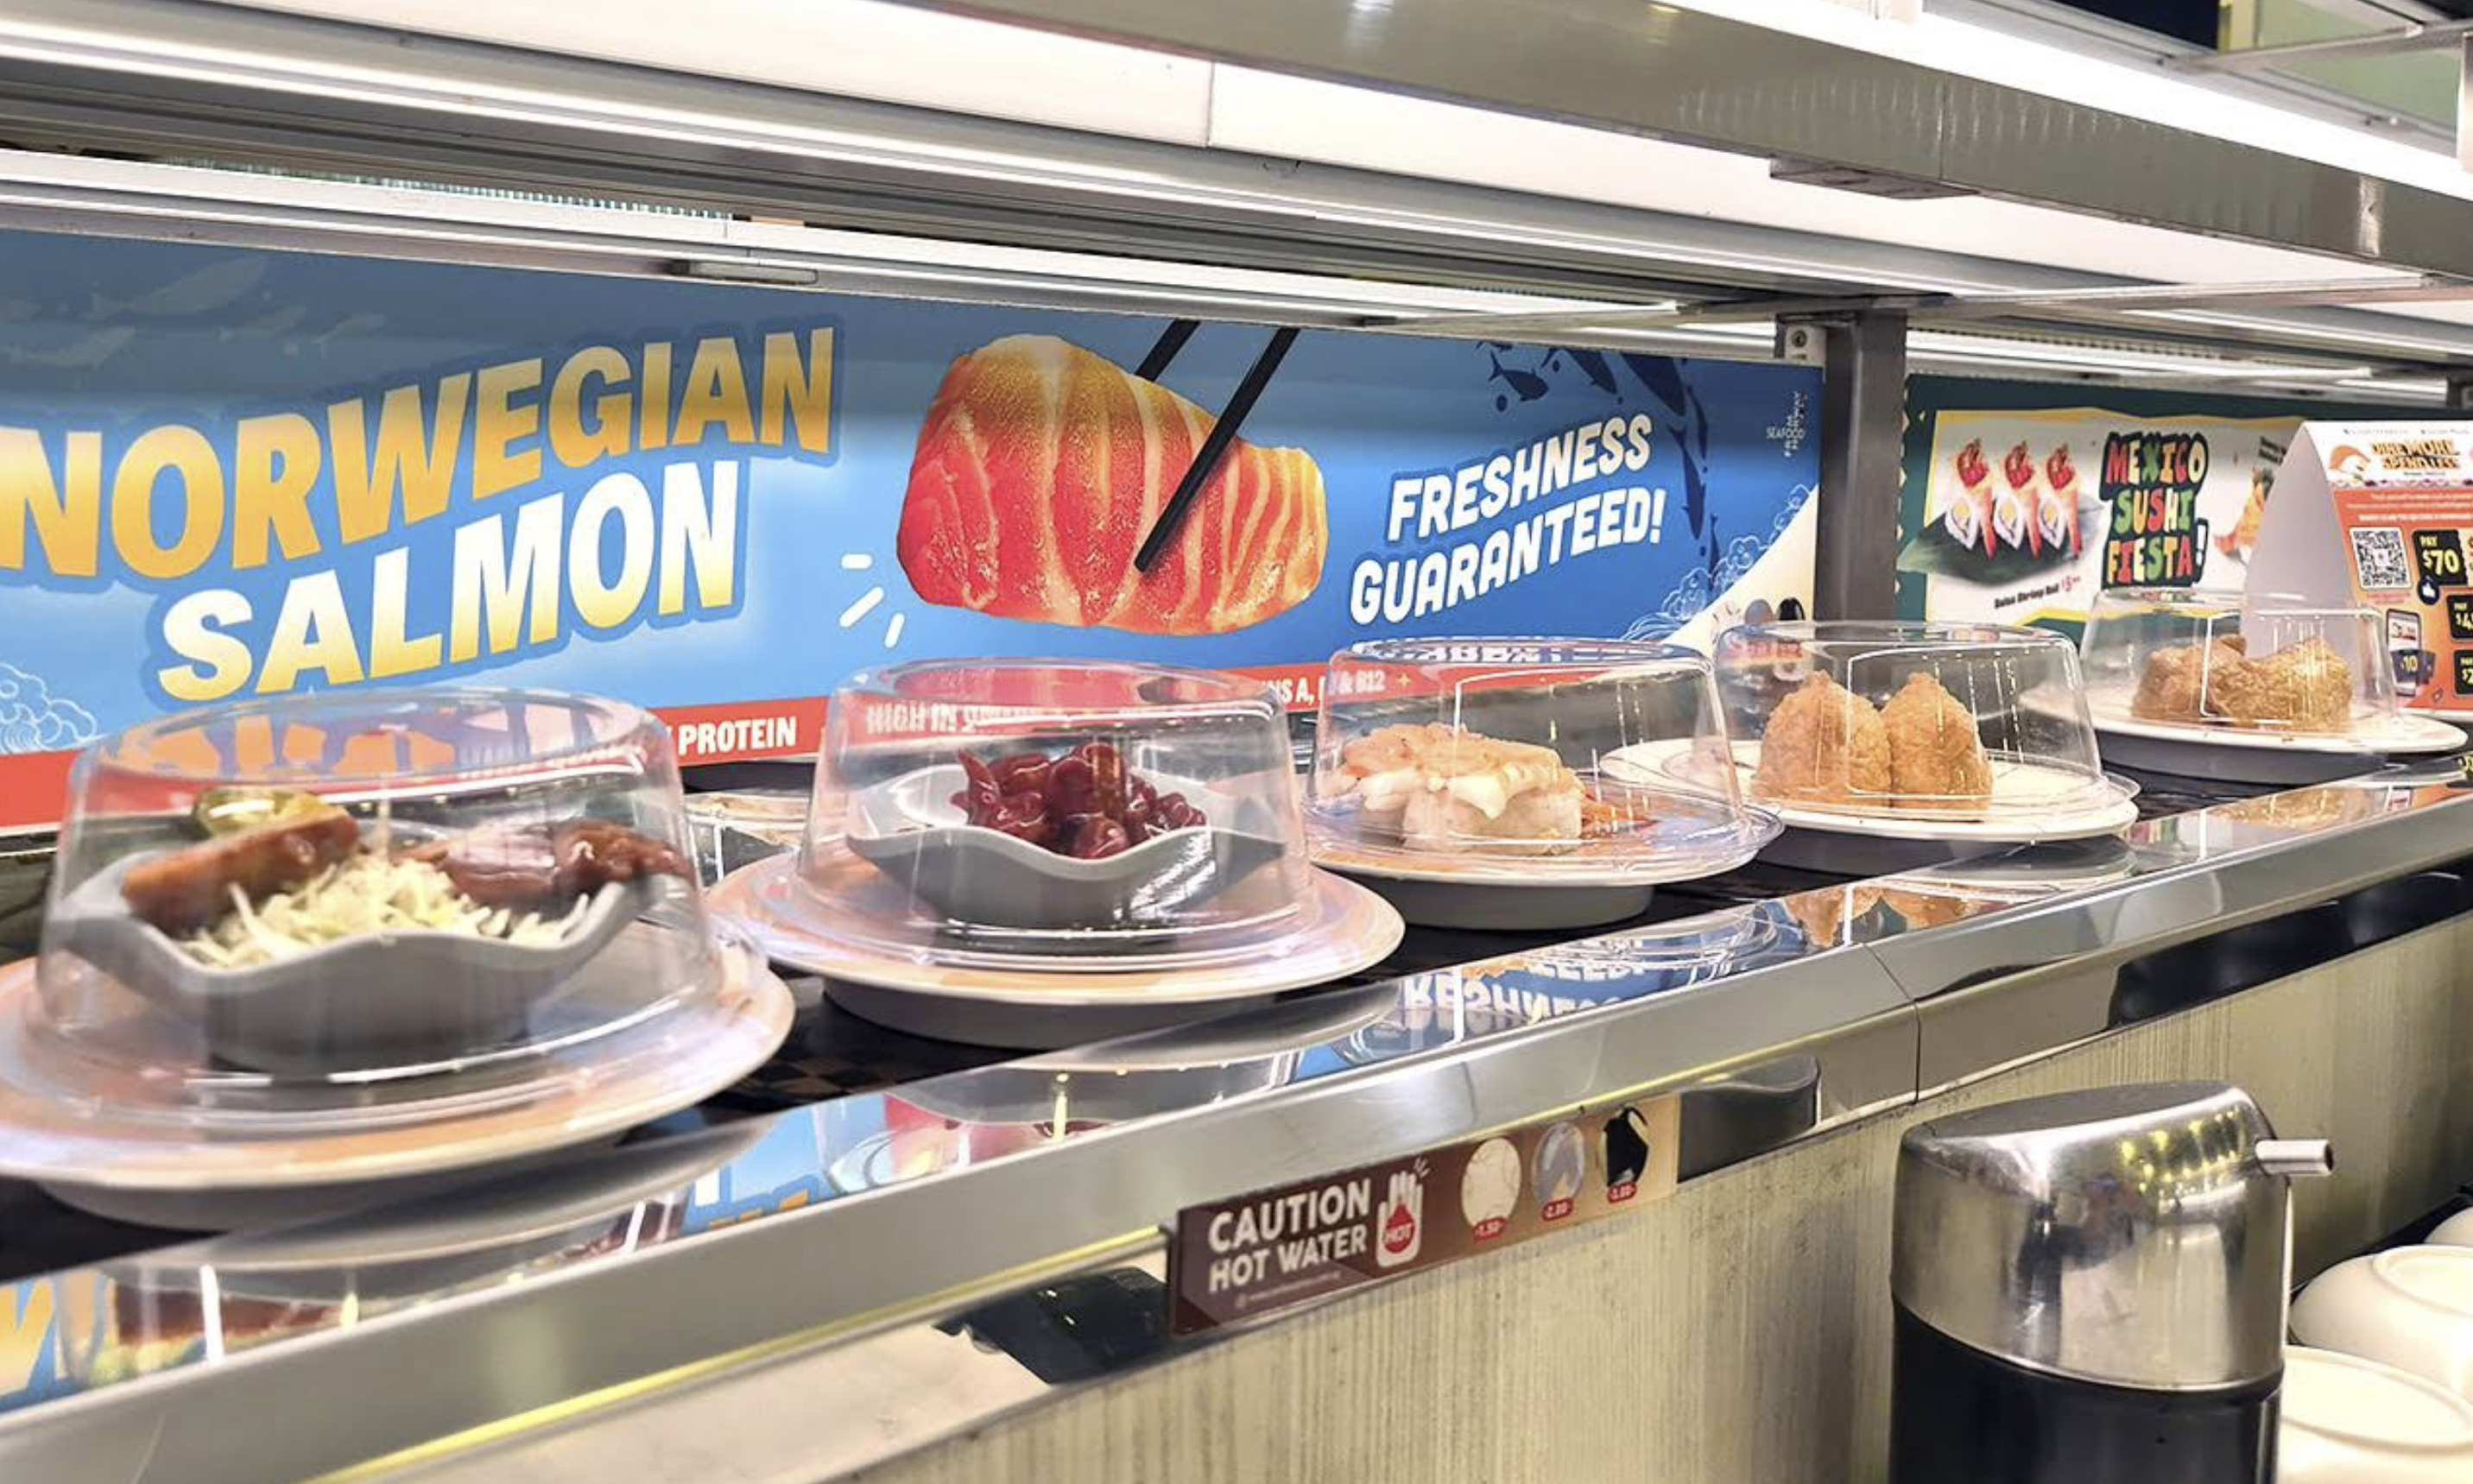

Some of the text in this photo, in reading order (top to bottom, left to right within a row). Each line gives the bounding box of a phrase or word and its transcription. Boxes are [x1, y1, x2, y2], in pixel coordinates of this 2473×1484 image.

[0, 326, 835, 579] NORWEGIAN
[1388, 414, 1653, 541] FRESHNESS
[2107, 439, 2206, 485] MEXICO
[2114, 487, 2194, 534] SUSHI
[158, 460, 739, 701] SALMON
[1350, 488, 1666, 625] GUARANTEED!
[2108, 520, 2207, 584] FIESTA!
[2423, 549, 2460, 576] $70
[679, 717, 796, 755] PROTEIN
[1209, 1179, 1370, 1254] CAUTION
[1383, 1222, 1414, 1244] HOT
[1210, 1248, 1269, 1292] HOT
[1276, 1224, 1367, 1273] WATER
